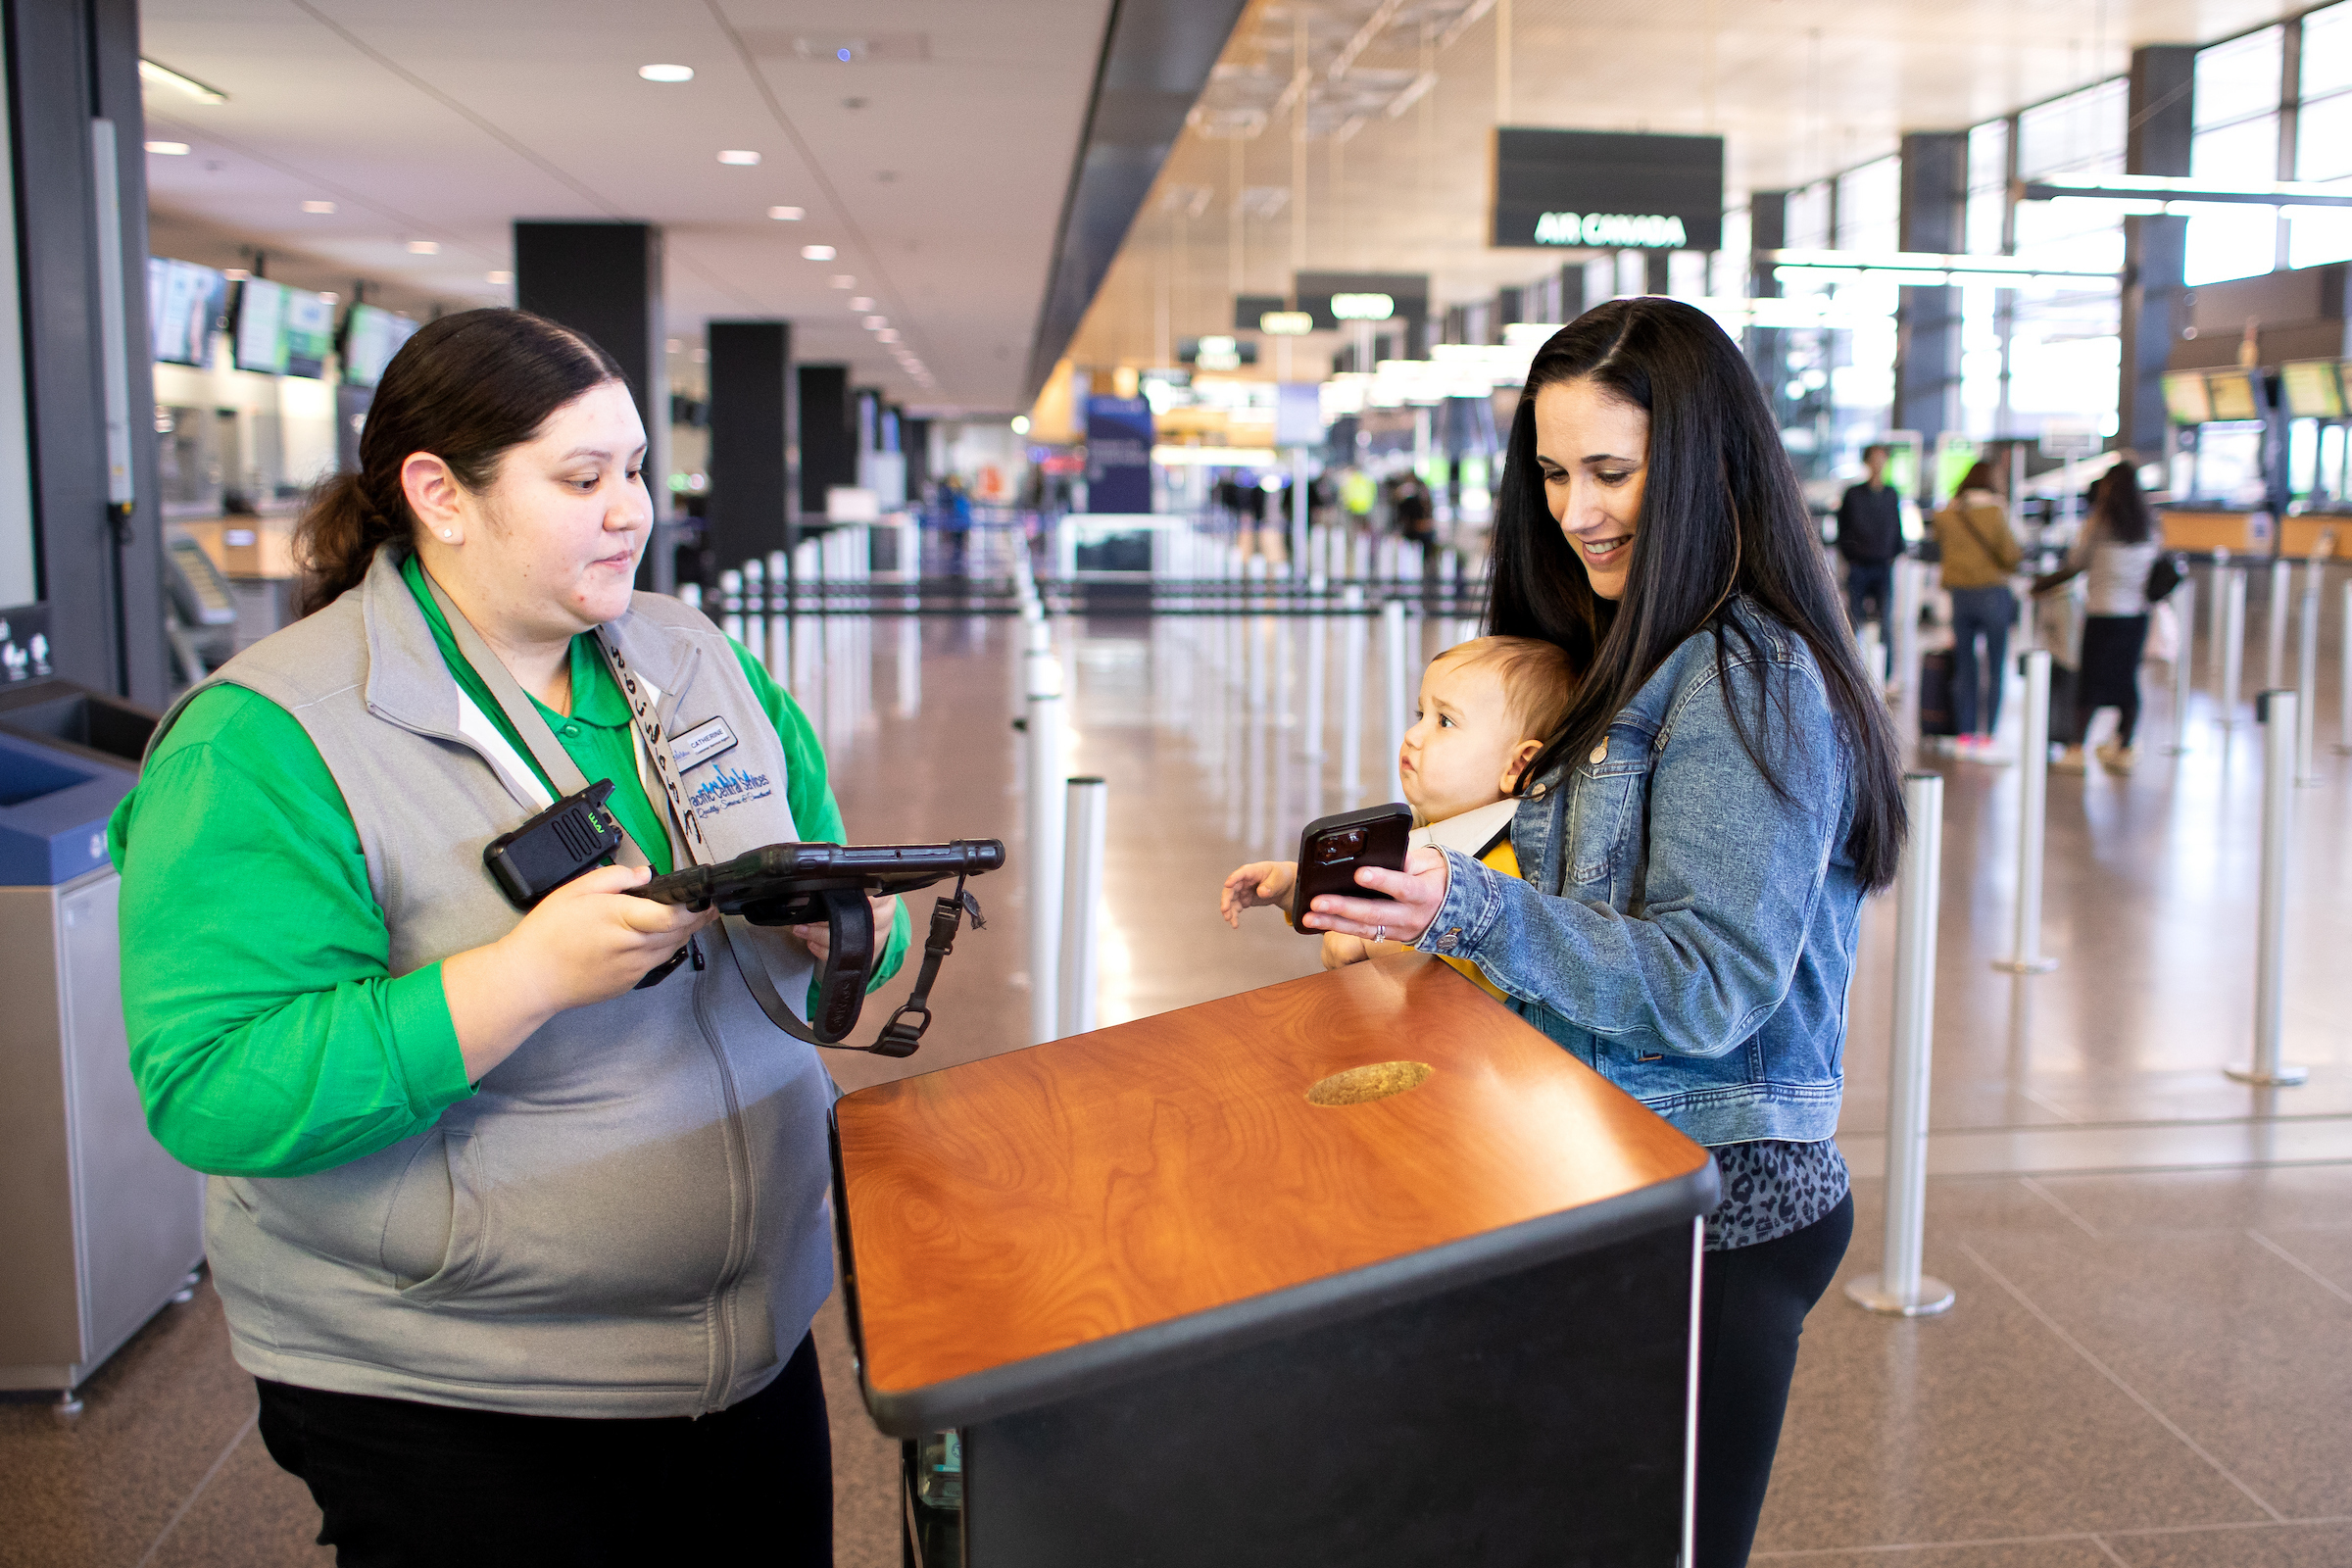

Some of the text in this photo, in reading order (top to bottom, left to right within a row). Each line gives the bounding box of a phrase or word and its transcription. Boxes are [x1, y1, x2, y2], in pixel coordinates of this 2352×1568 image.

[1535, 212, 1687, 248] AIR CANADA
[691, 729, 723, 748] CATHERINE
[691, 774, 769, 807] acific Central Services
